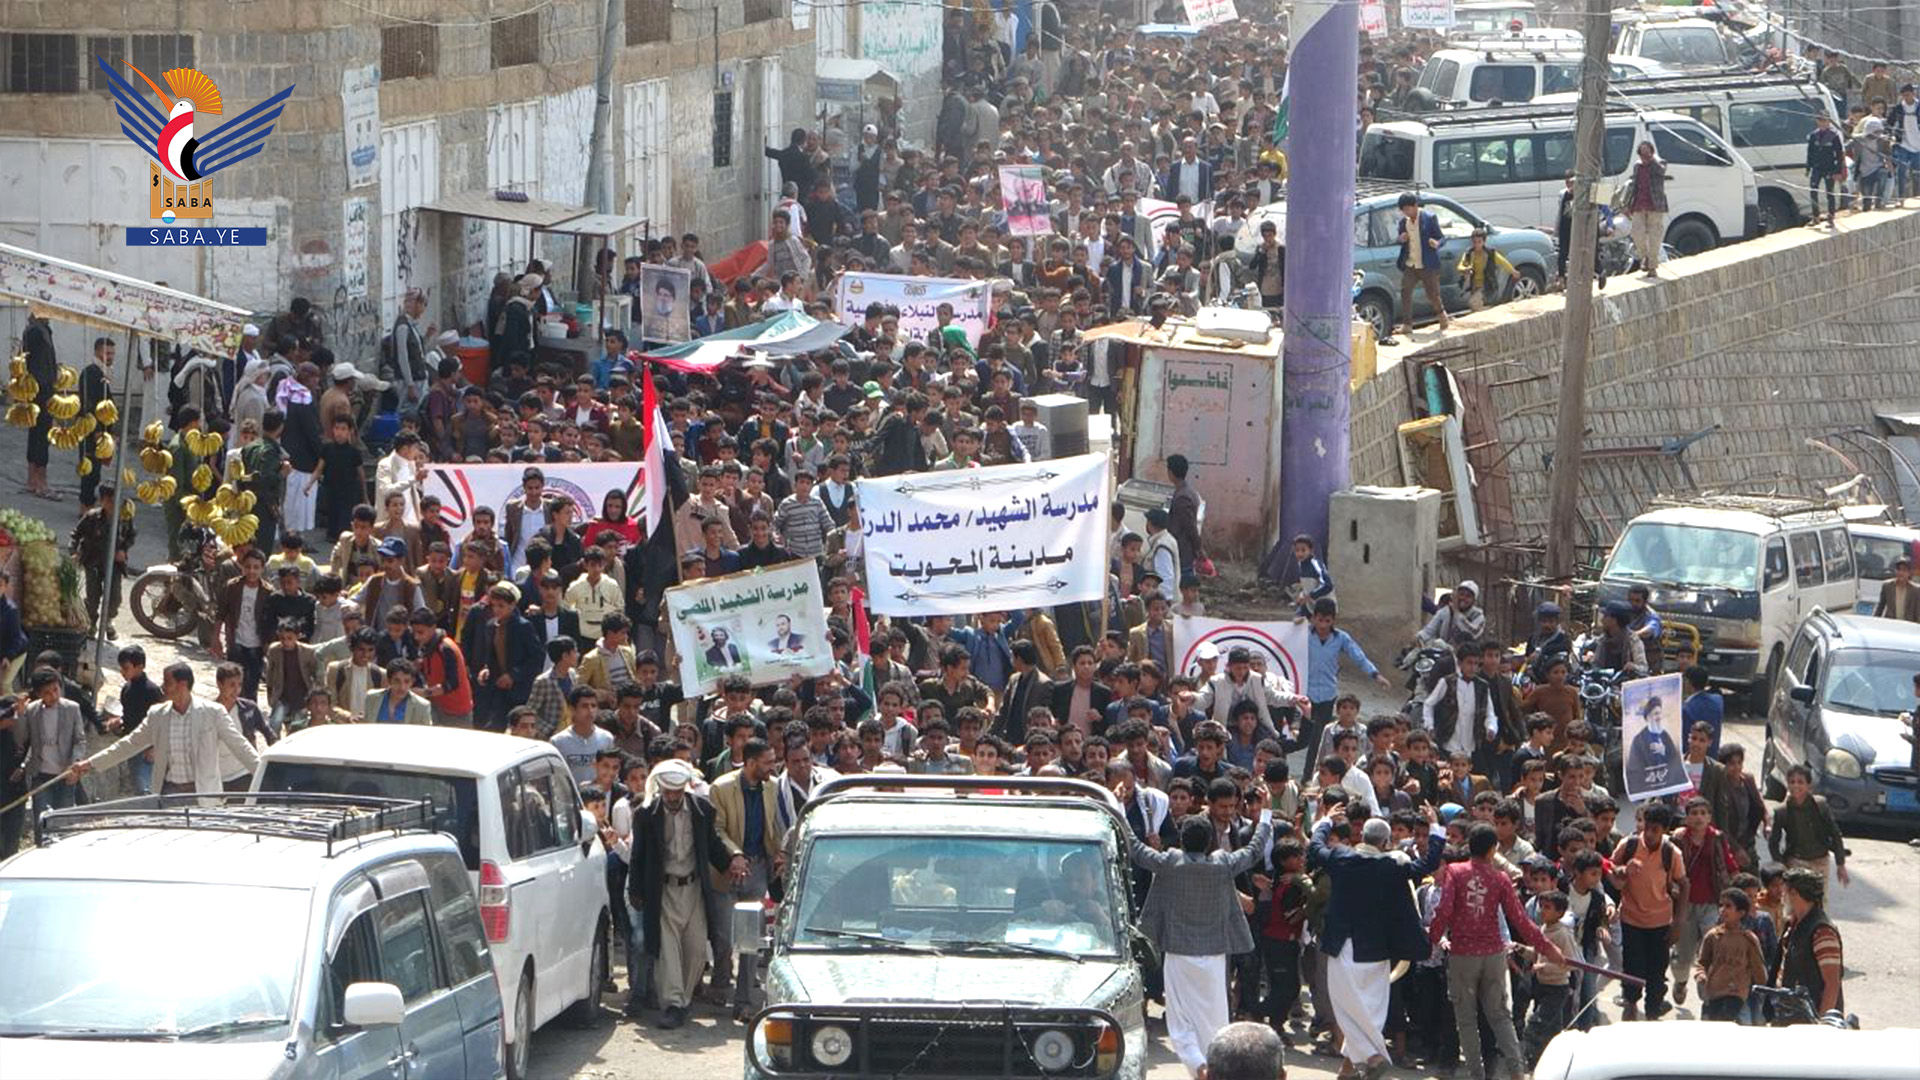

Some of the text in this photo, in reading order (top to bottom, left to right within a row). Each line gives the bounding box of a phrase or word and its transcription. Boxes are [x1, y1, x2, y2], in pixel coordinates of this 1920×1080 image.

[901, 304, 936, 321] لنبلاء
[952, 307, 983, 321] مدرس
[1041, 492, 1099, 520] مدرسة
[907, 509, 960, 533] محمد
[889, 544, 1073, 584] مدينة المحويت
[719, 586, 764, 613] الشهيد
[767, 581, 809, 600] مدرسة
